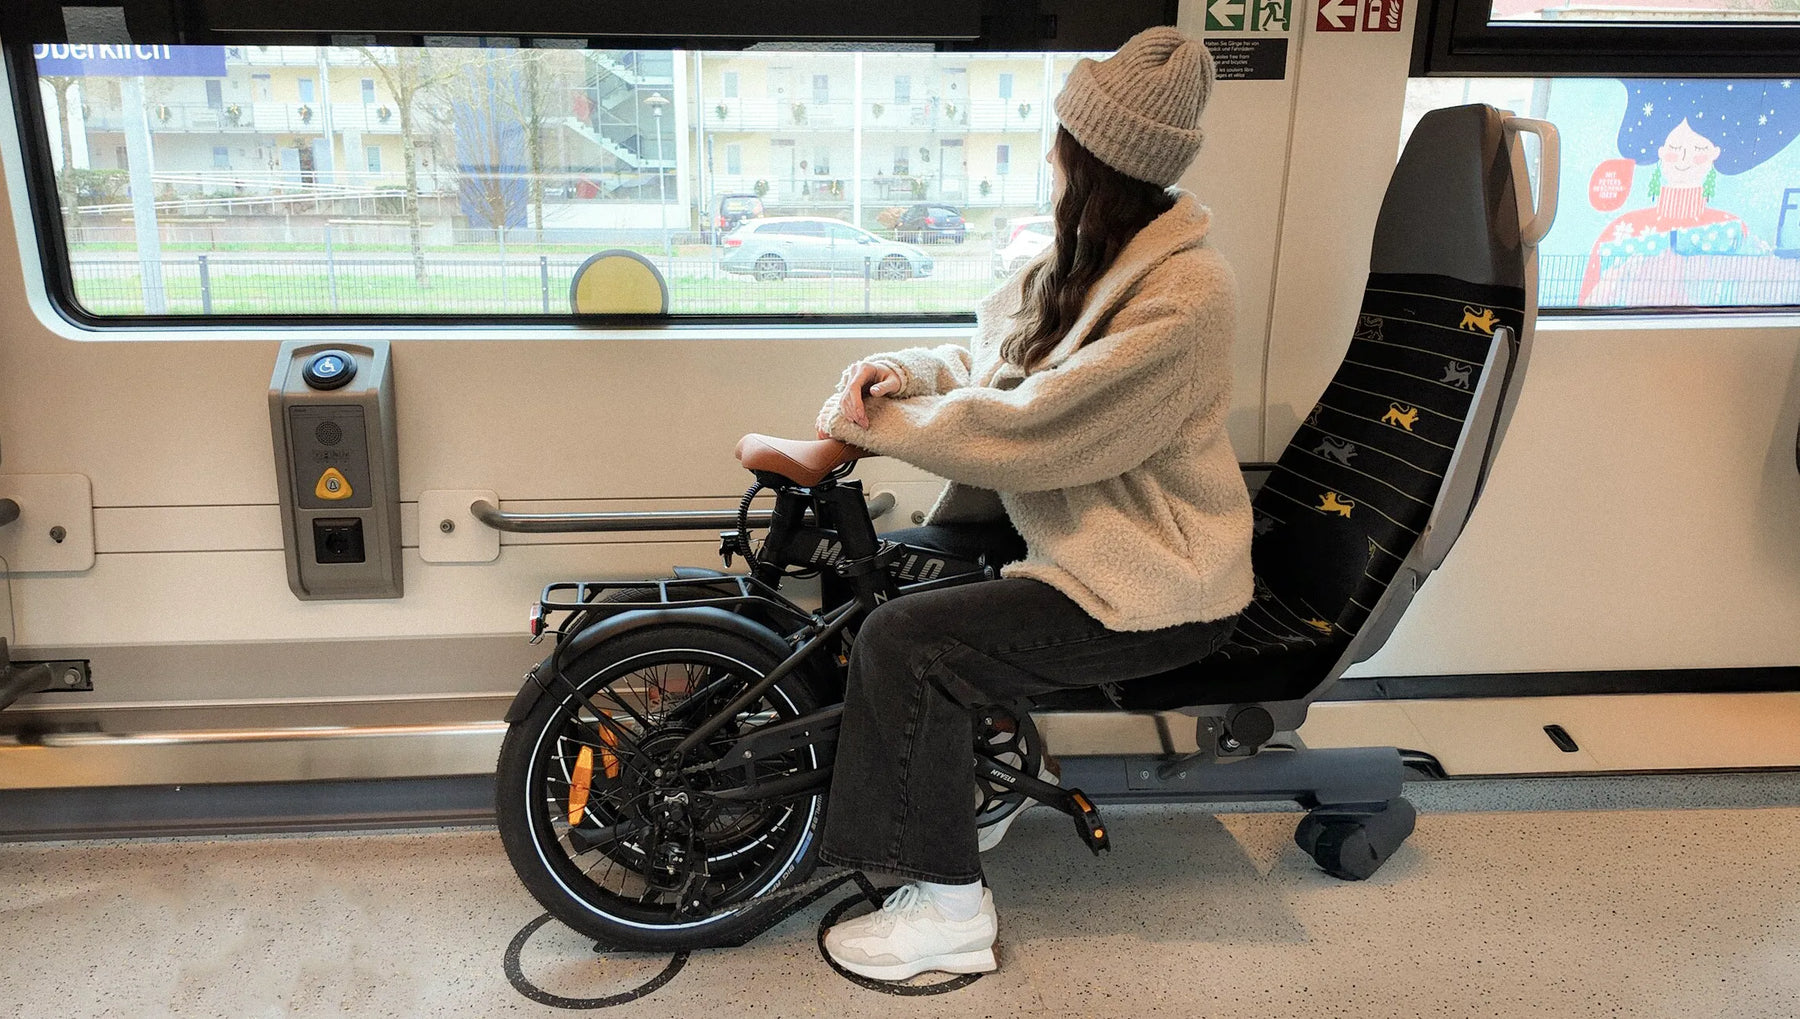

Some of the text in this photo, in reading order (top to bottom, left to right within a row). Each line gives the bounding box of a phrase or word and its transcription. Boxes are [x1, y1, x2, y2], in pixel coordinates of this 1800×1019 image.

[1775, 188, 1800, 248] F
[990, 768, 1017, 784] MYVELO
[783, 864, 795, 880] BIG
